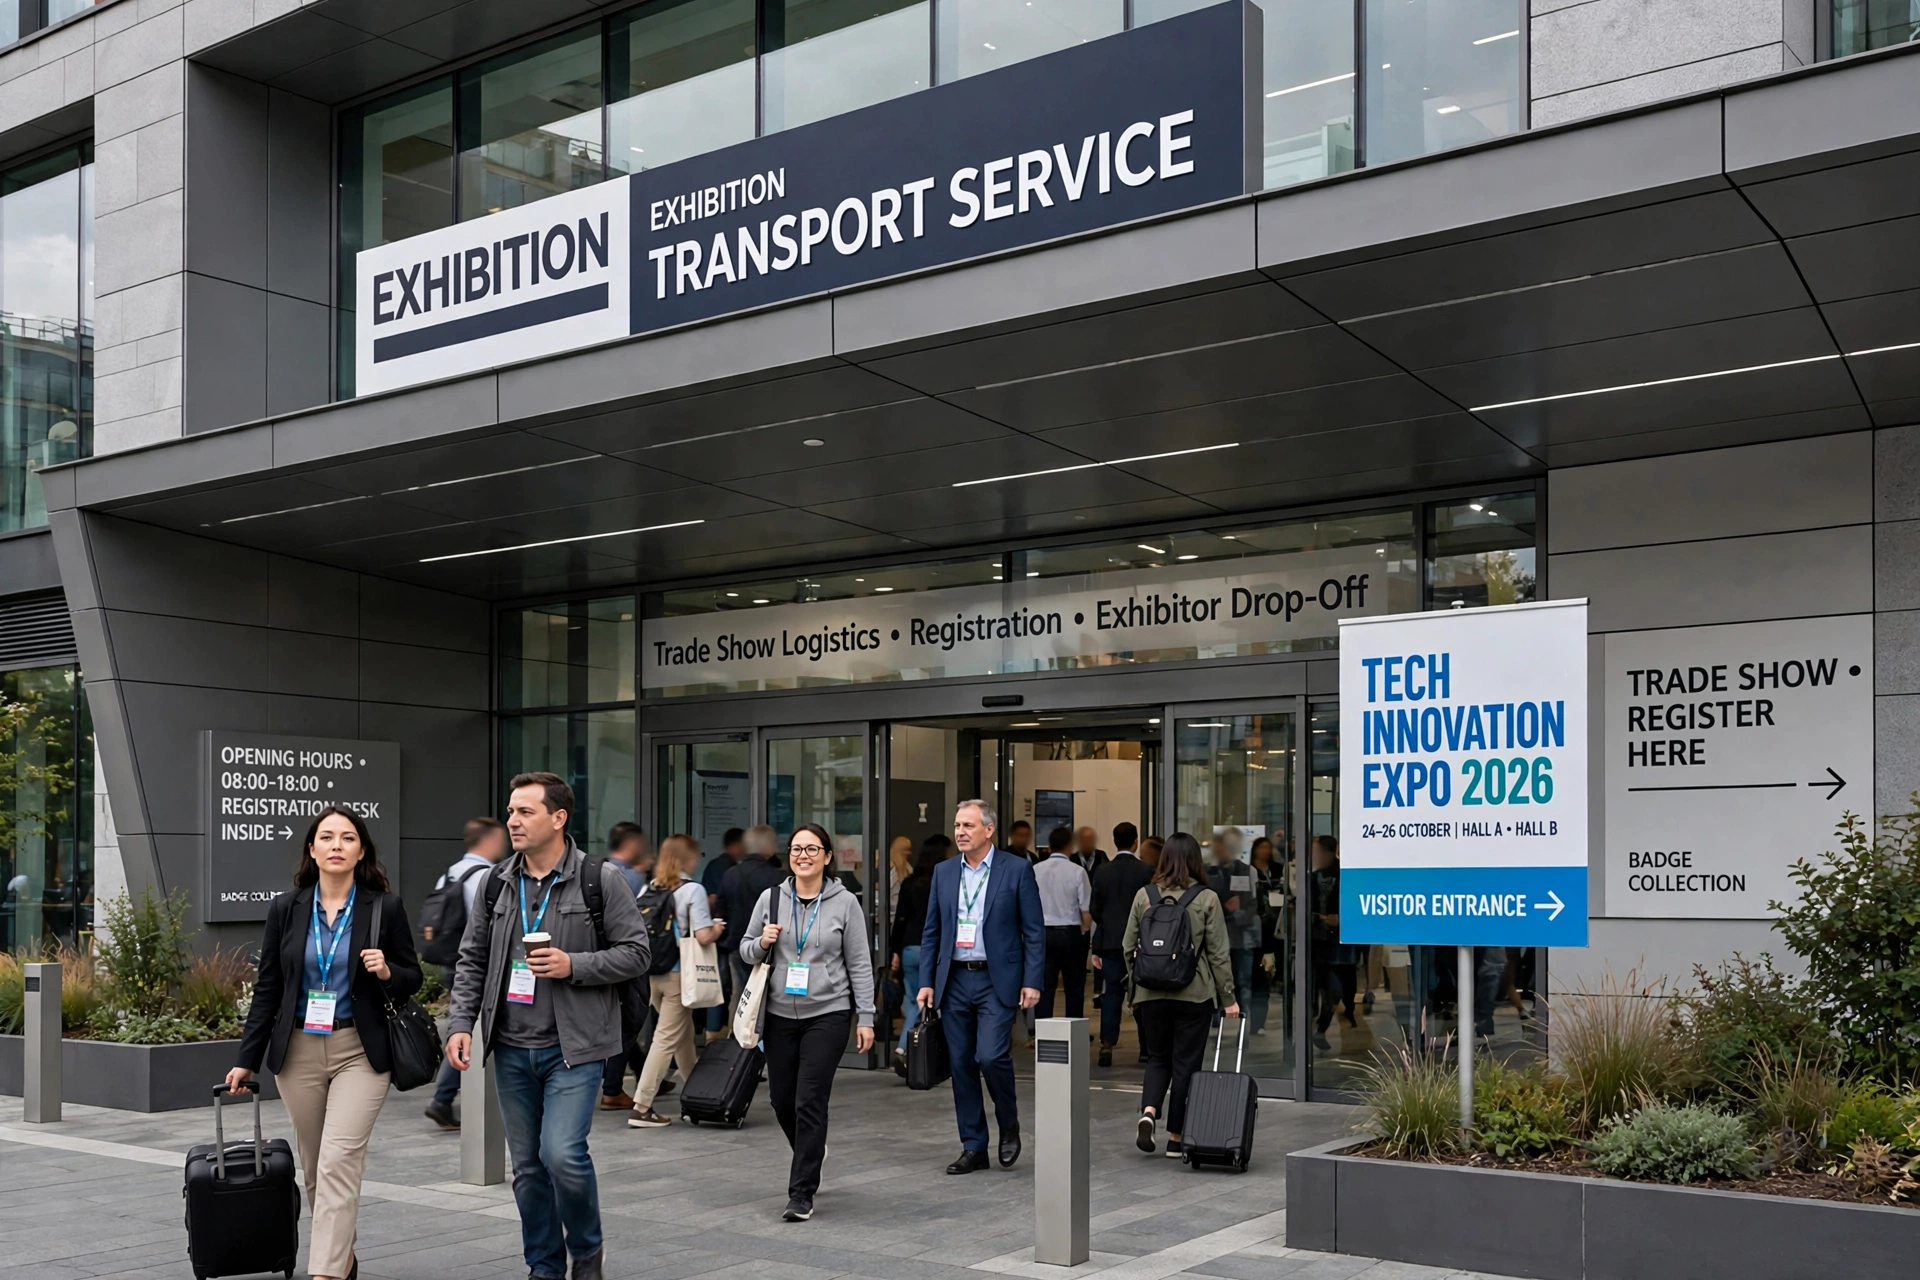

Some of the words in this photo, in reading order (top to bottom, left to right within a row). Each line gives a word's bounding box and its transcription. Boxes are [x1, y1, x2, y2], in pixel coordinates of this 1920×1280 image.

[648, 177, 935, 300] TRANSPORT
[949, 109, 1194, 228] SERVICE
[651, 168, 784, 231] EXHIBITION
[374, 212, 608, 325] EXHIBITION
[654, 639, 710, 666] Trade
[717, 634, 775, 661] Show
[783, 623, 880, 661] Logistics
[911, 612, 1061, 650] Registration
[1097, 591, 1219, 630] Exhibitor
[1232, 574, 1369, 622] Drop-Off
[1362, 653, 1449, 702] TECH
[1627, 665, 1727, 696] TRADE
[1739, 658, 1838, 690] SHOW
[1364, 701, 1564, 755] INNOVATION
[1629, 700, 1775, 732] REGISTER
[222, 747, 294, 766] OPENING
[300, 751, 352, 769] HOURS
[1629, 739, 1705, 767] HERE
[1363, 761, 1450, 808] EXPO
[1462, 757, 1553, 805] 2026
[222, 824, 274, 840] INSIDE
[1399, 823, 1450, 837] OCTOBER
[1463, 822, 1491, 836] HALL
[1495, 822, 1502, 836] A
[1516, 821, 1546, 836] HALL
[1550, 821, 1557, 835] B
[1630, 852, 1692, 868] BADGE
[1629, 875, 1745, 891] COLLECTION
[1359, 894, 1426, 915] VISITOR
[1432, 895, 1526, 916] ENTRANCE
